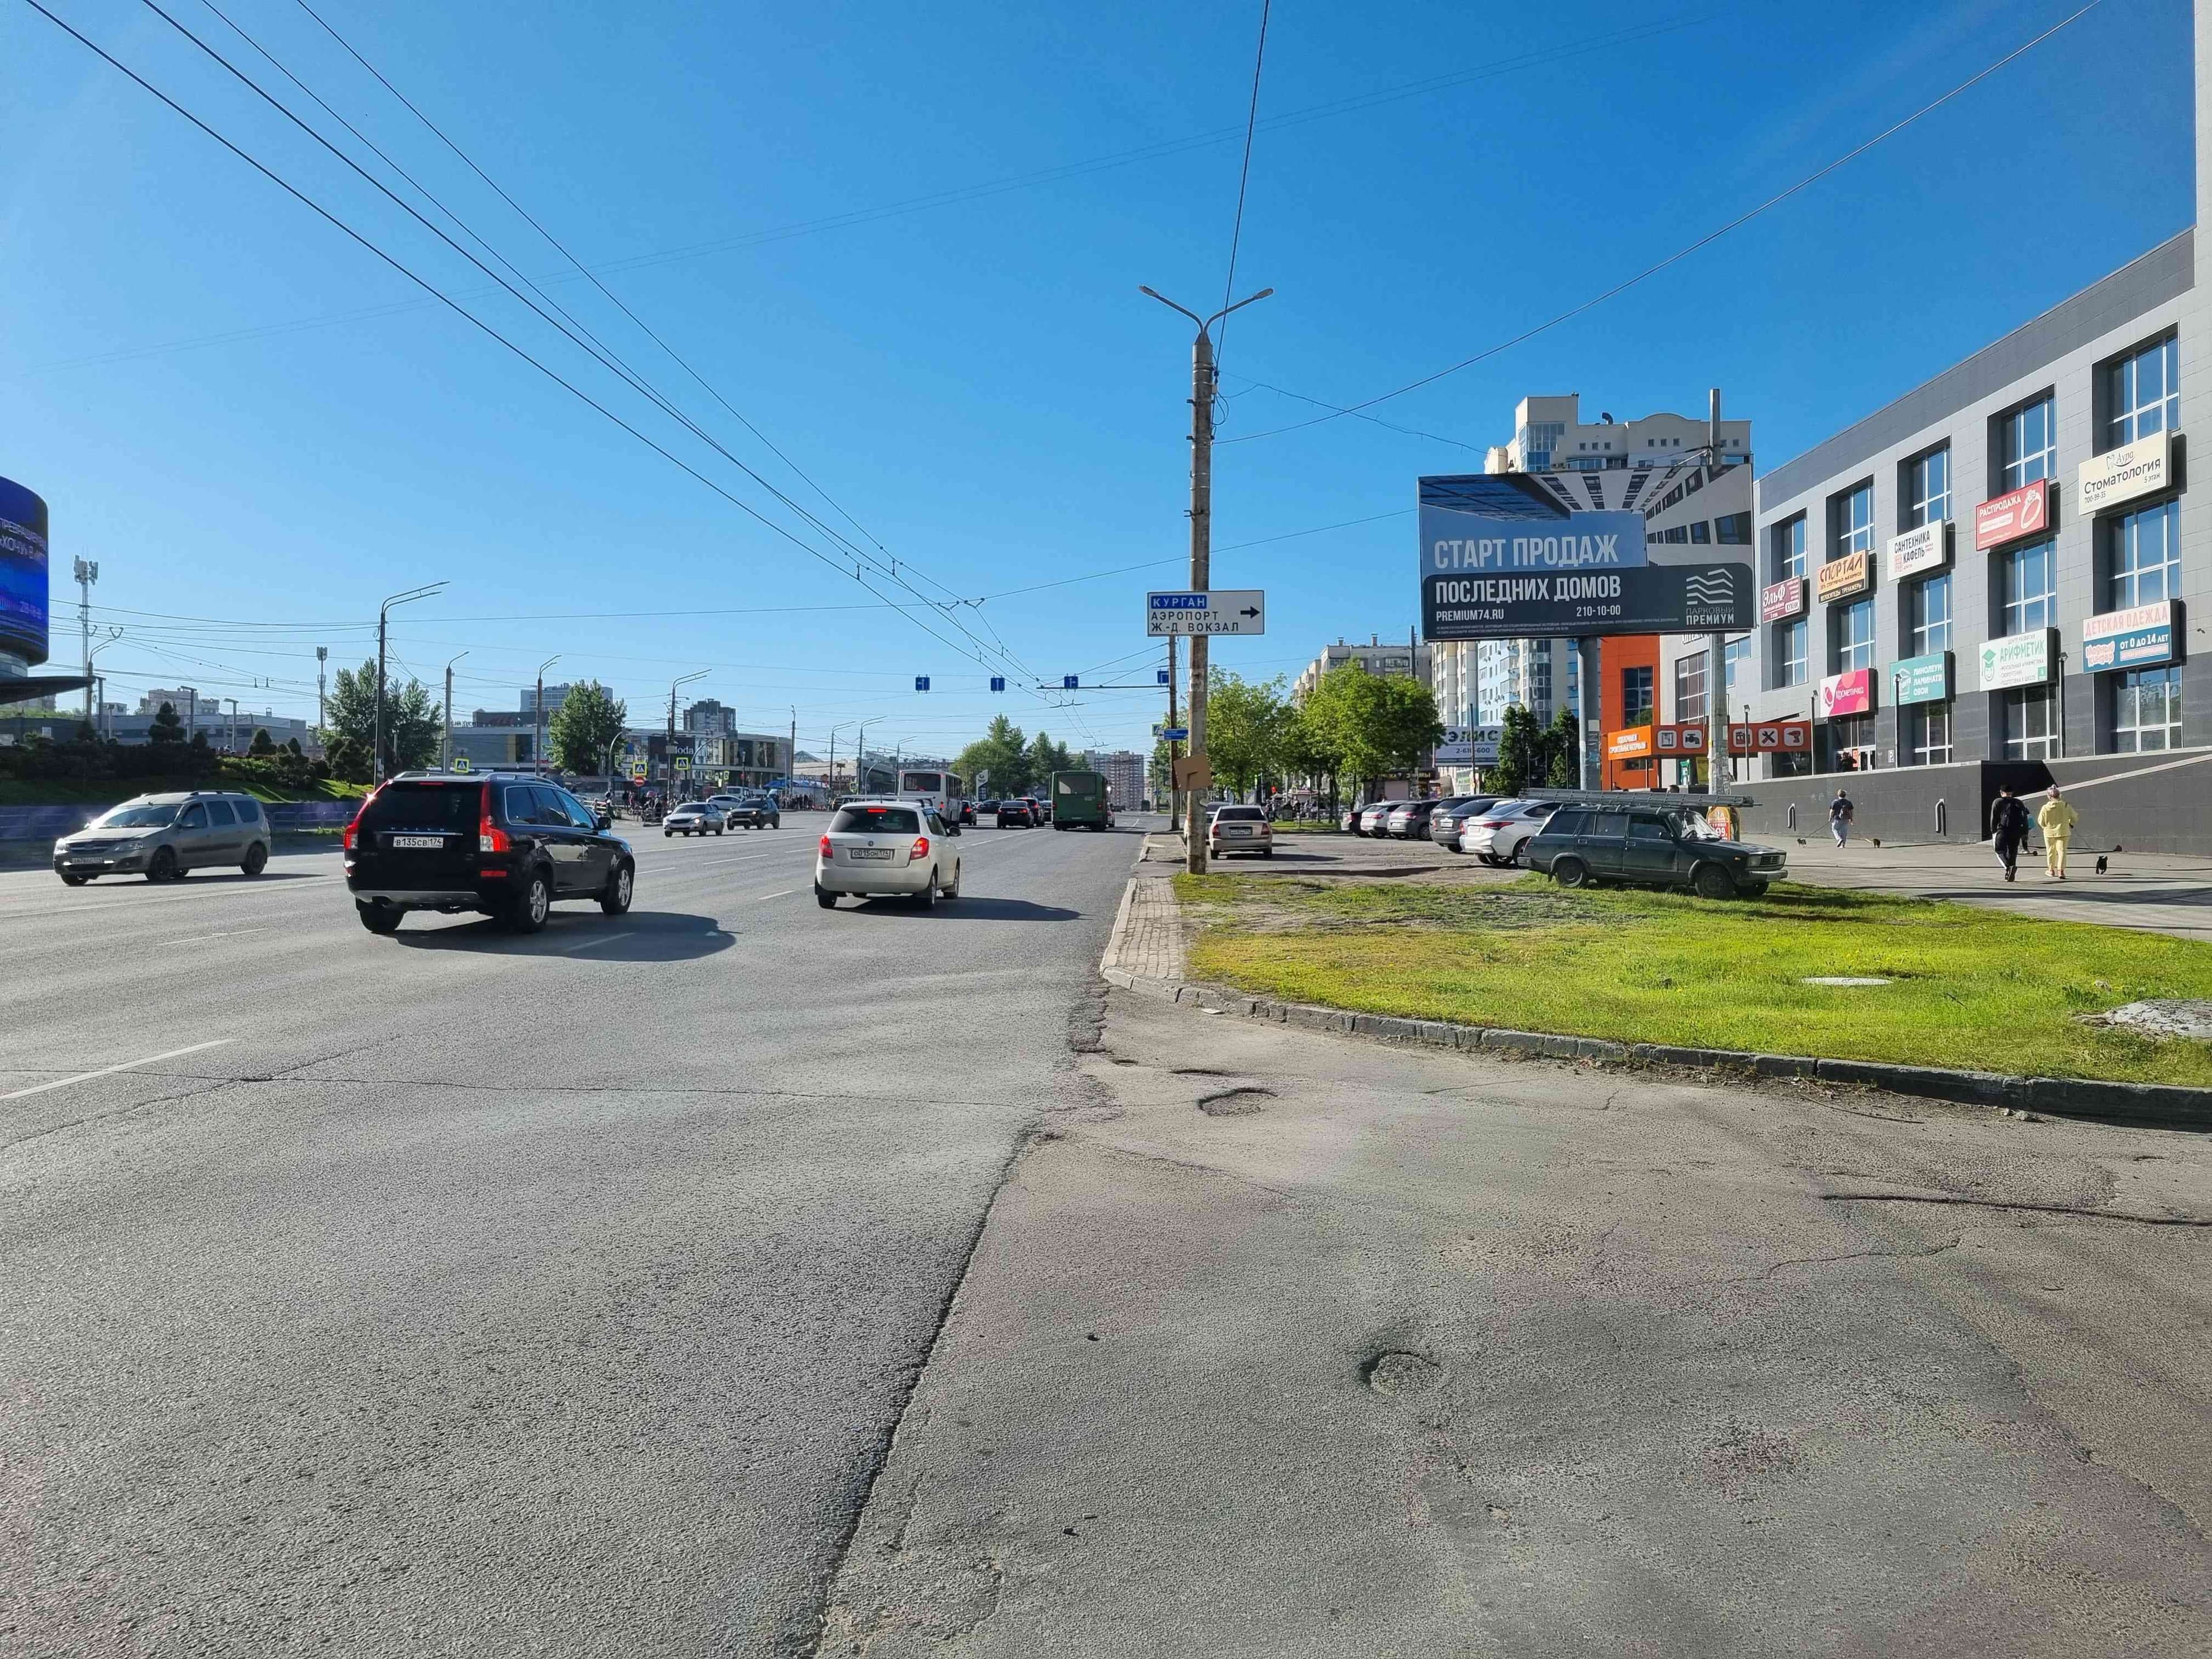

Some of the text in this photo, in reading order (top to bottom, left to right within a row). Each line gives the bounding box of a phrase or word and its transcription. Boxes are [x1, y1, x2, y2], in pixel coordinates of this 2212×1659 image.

[2116, 451, 2134, 464] Аура
[2084, 459, 2160, 494] Стоматология
[1979, 495, 2021, 517] РАСПРОДАЖА
[1894, 531, 1930, 553] САНТЕХНИКА
[1434, 535, 1619, 569] СТАРТ ПРОДАЖ
[1903, 547, 1925, 563] КАФЕЛЬ
[1435, 575, 1621, 604] ПОСЛЕДНИХ ДОМОВ
[1153, 597, 1205, 607] КУРГАН
[1152, 611, 1218, 620] АЭРОПОРТ
[1436, 605, 1620, 622] PREMIUM74.RU 210-10-00
[1686, 607, 1734, 615] ПАРКОВЫЙ
[1188, 622, 1238, 632] ВОКЗАЛ
[1686, 613, 1734, 626] ПРЕМИУМ
[2085, 605, 2168, 637] ДЕТСКАЯ ОДЕЖДА
[2120, 634, 2169, 649] ОТ 0 ДО 14 ЛЕТ
[2000, 641, 2045, 662] АРИФМЕТИК
[1913, 664, 1942, 676] ЛИНОЛЕУМ
[1913, 687, 1929, 696] ОБОИ
[674, 746, 694, 754] oda
